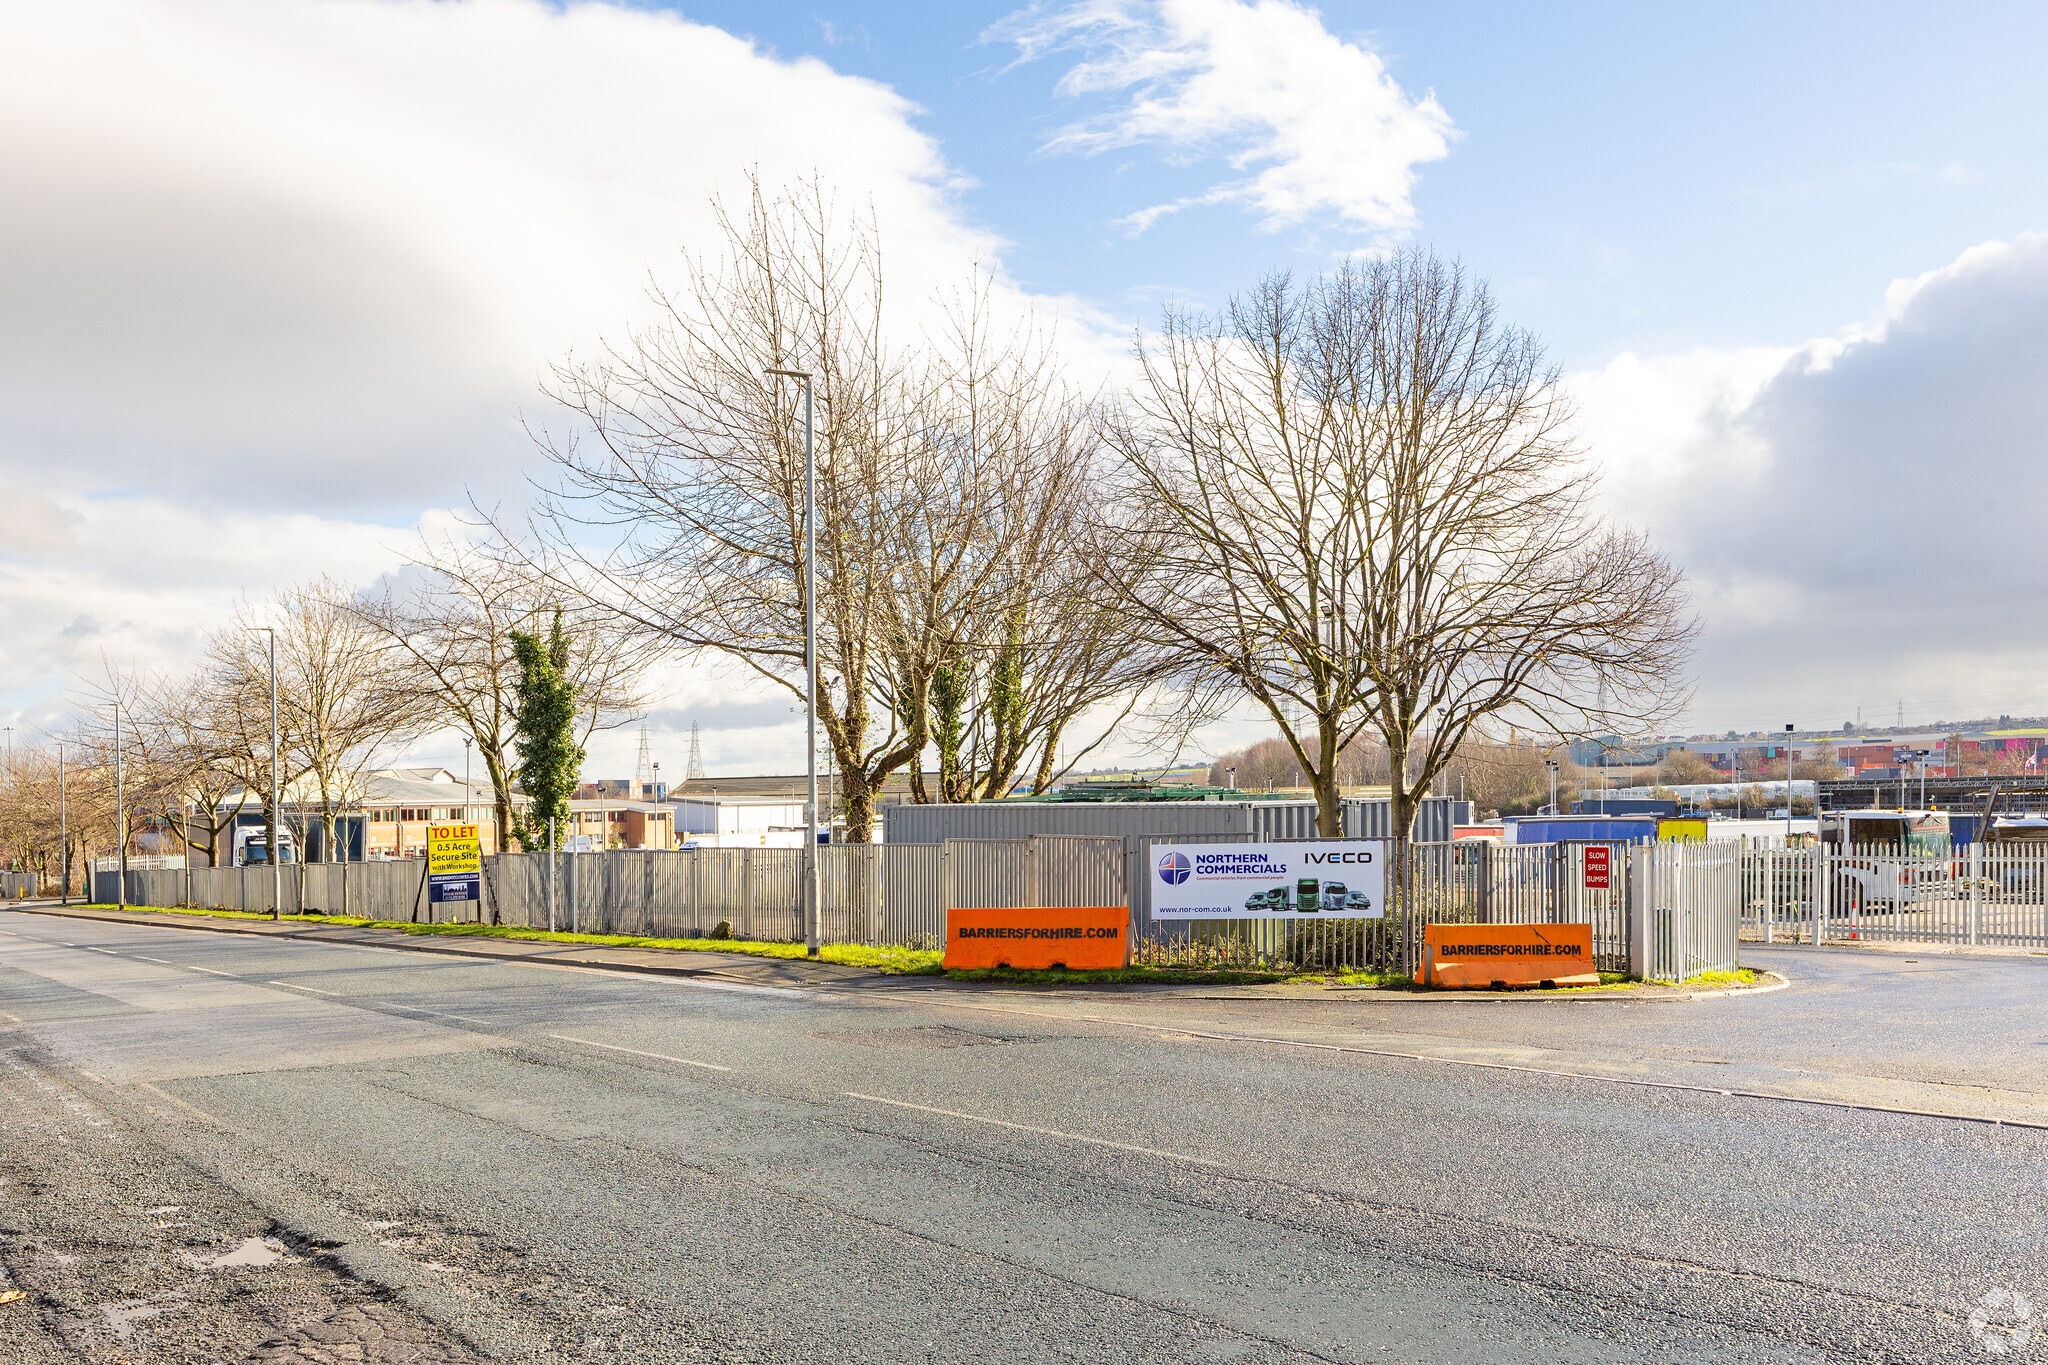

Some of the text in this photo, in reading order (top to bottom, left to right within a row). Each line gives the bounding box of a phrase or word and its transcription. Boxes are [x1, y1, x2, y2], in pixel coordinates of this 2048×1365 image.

[432, 826, 475, 839] TO LET
[437, 843, 471, 852] 0.5 Acre
[431, 852, 477, 862] Secure Site
[1196, 854, 1268, 864] NORTHERN
[1304, 852, 1372, 864] IVECO
[446, 862, 477, 870] Workshop
[1196, 864, 1287, 874] COMMERCIALS
[1586, 875, 1608, 883] BUMPS
[1159, 905, 1232, 913] www.nor-com.co.uk
[959, 927, 1118, 939] BARRIERSFORHIRE.COM
[1441, 944, 1581, 956] BARRIERSFORHIRE.COM
